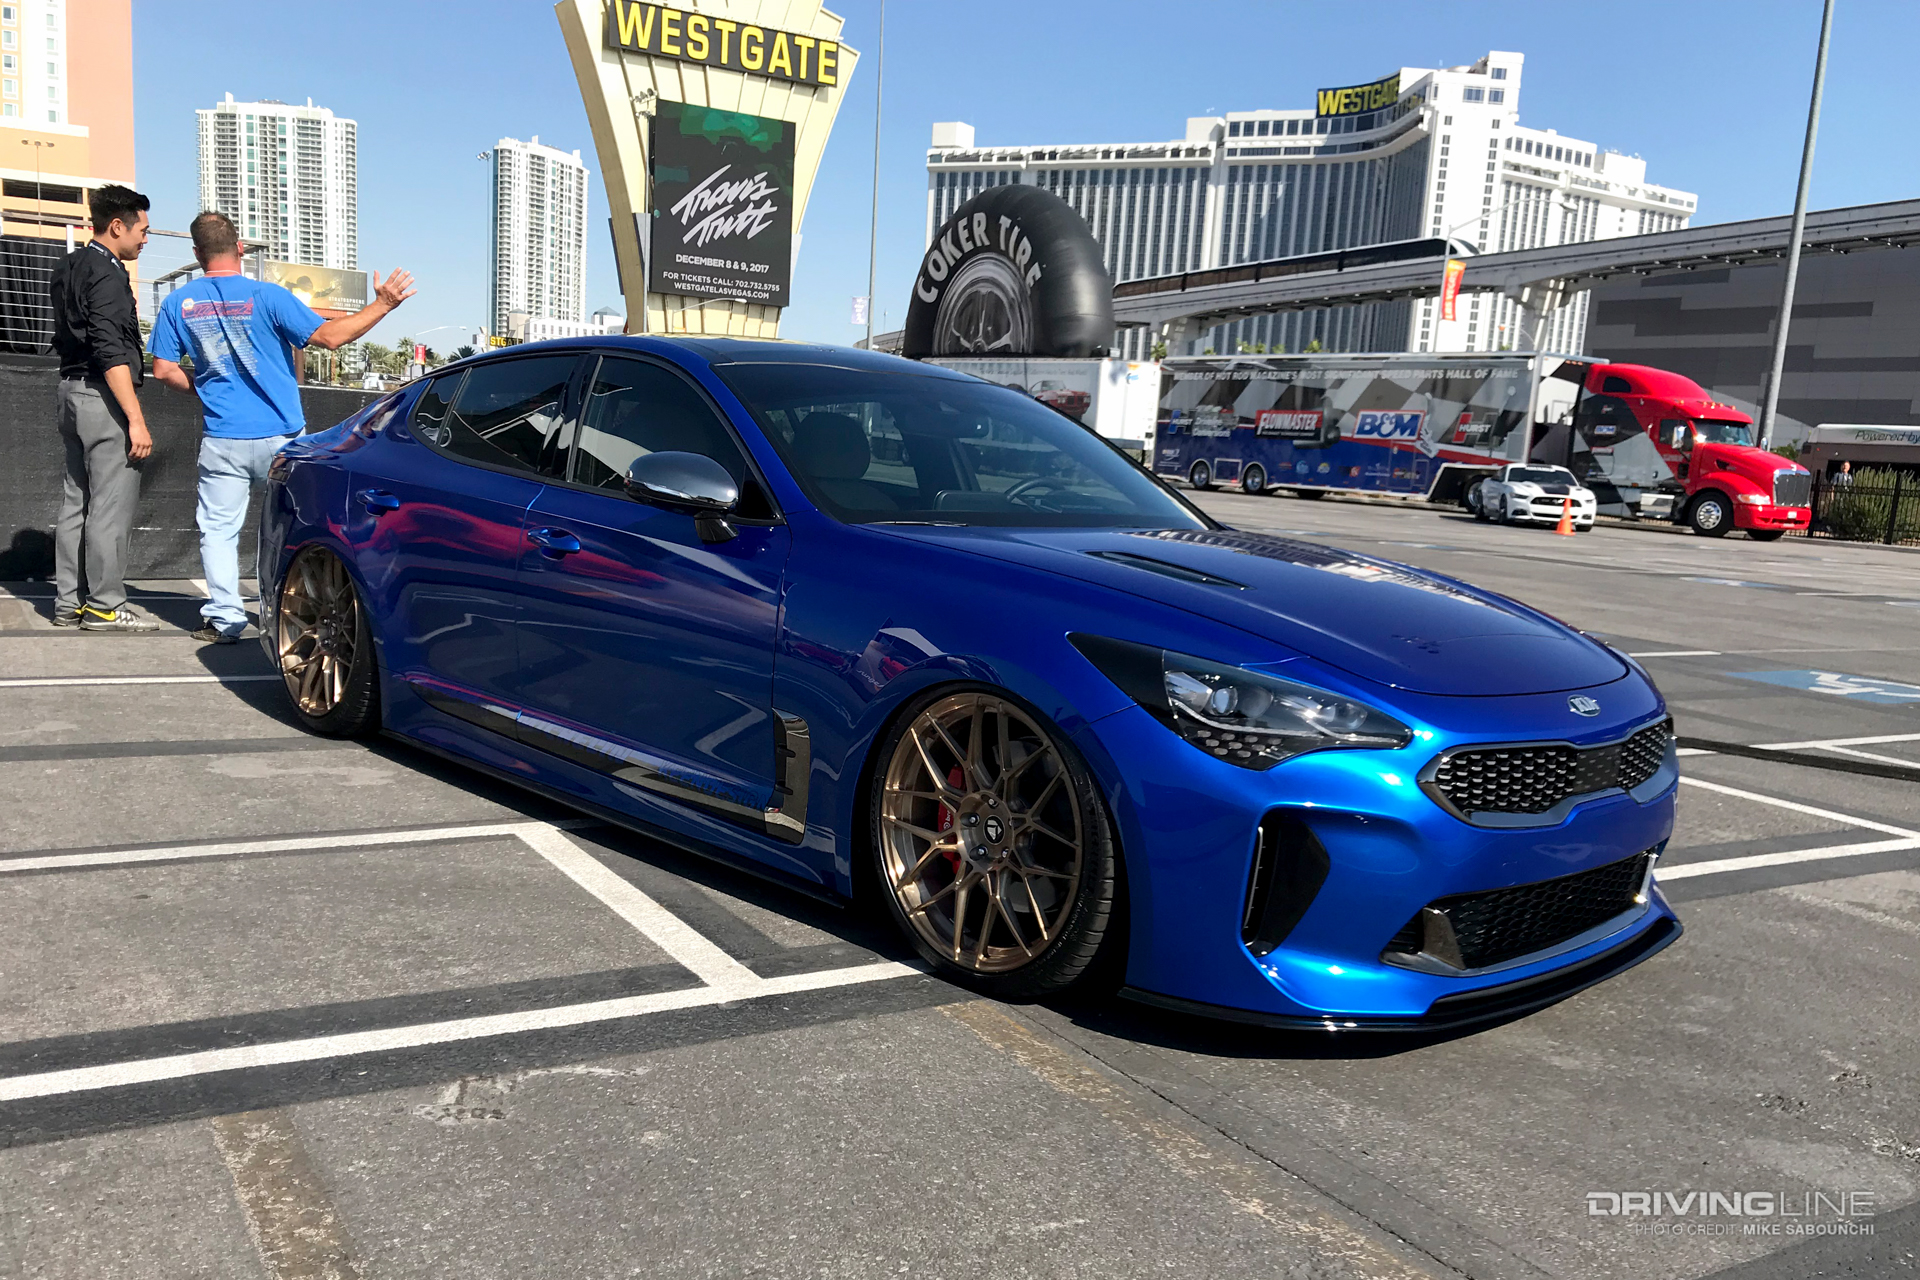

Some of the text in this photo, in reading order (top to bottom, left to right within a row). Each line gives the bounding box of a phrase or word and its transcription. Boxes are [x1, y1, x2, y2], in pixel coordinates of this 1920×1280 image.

[615, 0, 838, 85] WESTGATE
[1318, 76, 1400, 116] WESTGATE
[670, 164, 780, 226] Travis
[682, 198, 778, 248] Tritt
[675, 254, 770, 274] DECEMBER 8 & 9, 2017
[917, 212, 991, 304] COKER
[998, 214, 1042, 292] TIRE
[663, 271, 780, 292] FOR TICKETS CALL: 702.732.5755
[674, 281, 770, 299] WESTGATELASVEGAS.COM
[1204, 371, 1214, 381] OF
[1216, 371, 1231, 381] HOT
[1231, 371, 1250, 381] ROD
[1413, 369, 1444, 379] PARTS
[1446, 369, 1472, 379] HALL
[1474, 368, 1488, 379] OF
[1490, 368, 1518, 379] FAME
[1171, 418, 1193, 426] HURST
[1256, 413, 1319, 435] FLOWMASTER
[1355, 413, 1421, 438] B&M
[1459, 424, 1492, 433] HURST
[1855, 430, 1920, 444] Powered by
